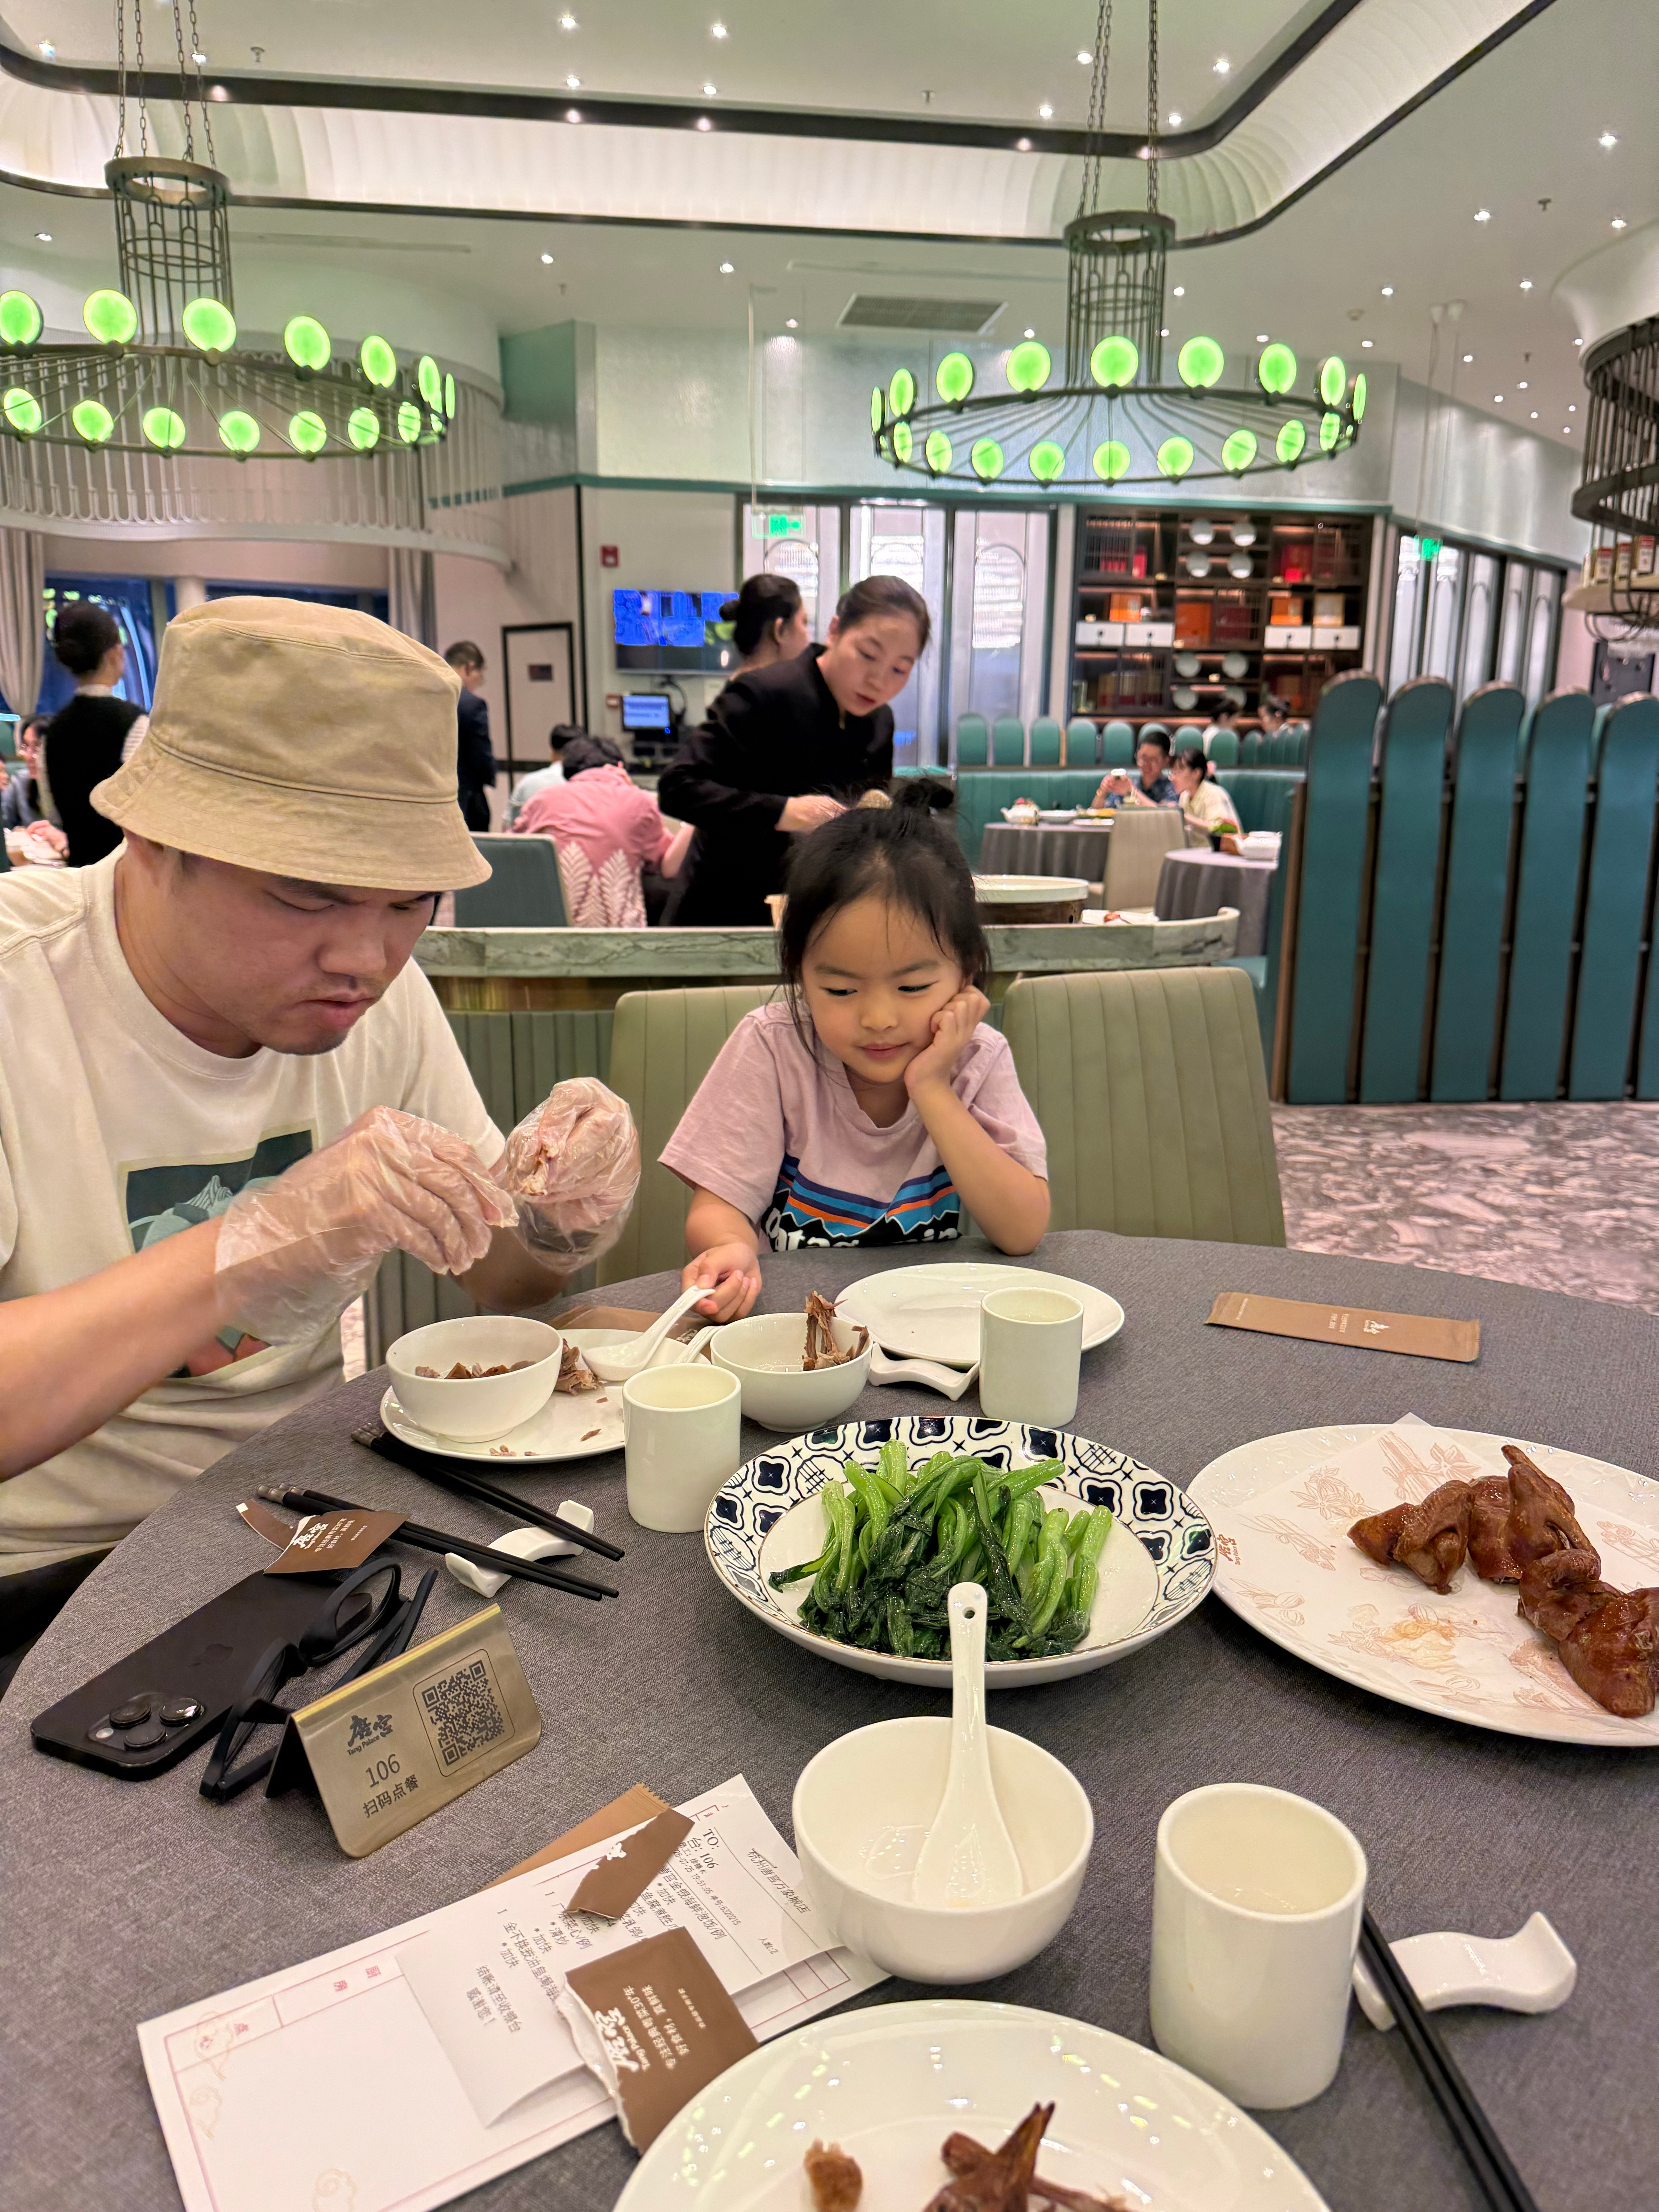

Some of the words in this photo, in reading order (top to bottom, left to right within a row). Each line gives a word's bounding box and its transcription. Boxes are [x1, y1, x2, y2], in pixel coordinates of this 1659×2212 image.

[348, 1714, 393, 1747] 唐宫
[347, 1745, 362, 1755] Tang
[362, 1735, 380, 1748] Palace
[366, 1754, 400, 1788] 106
[363, 1774, 419, 1818] 扫码点餐
[703, 1829, 719, 1850] TO:
[700, 1853, 719, 1868] 106
[692, 1874, 713, 1894] 19:51:05
[656, 1887, 676, 1905] 加快
[580, 1916, 600, 1934] 加快
[532, 1934, 552, 1954] 加快
[499, 1948, 520, 1968] 加快
